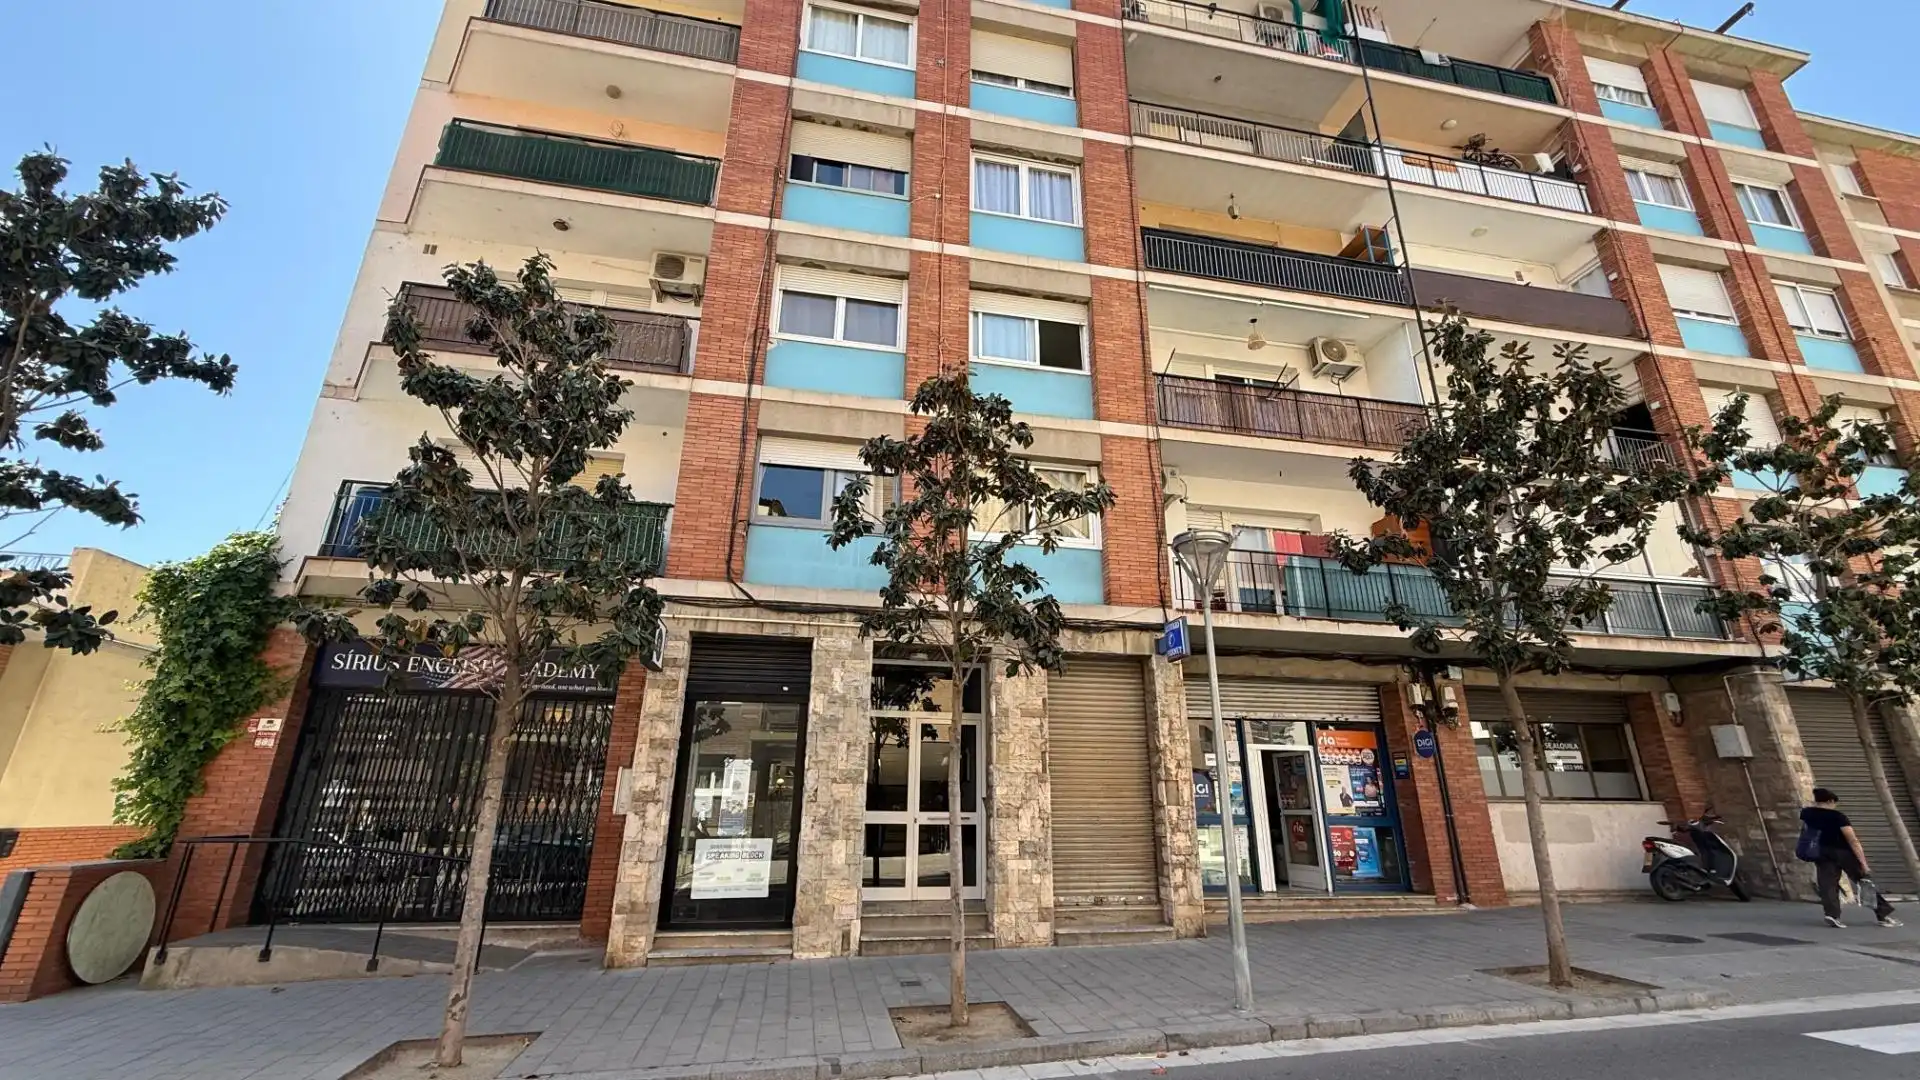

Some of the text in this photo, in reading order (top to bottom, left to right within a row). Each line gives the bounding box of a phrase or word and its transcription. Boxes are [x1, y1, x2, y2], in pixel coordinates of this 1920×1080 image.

[502, 661, 600, 679] ADEMY
[1318, 732, 1336, 745] ria
[1417, 738, 1433, 747] DIGI
[1193, 783, 1209, 794] IGI
[741, 851, 764, 860] BLOCK
